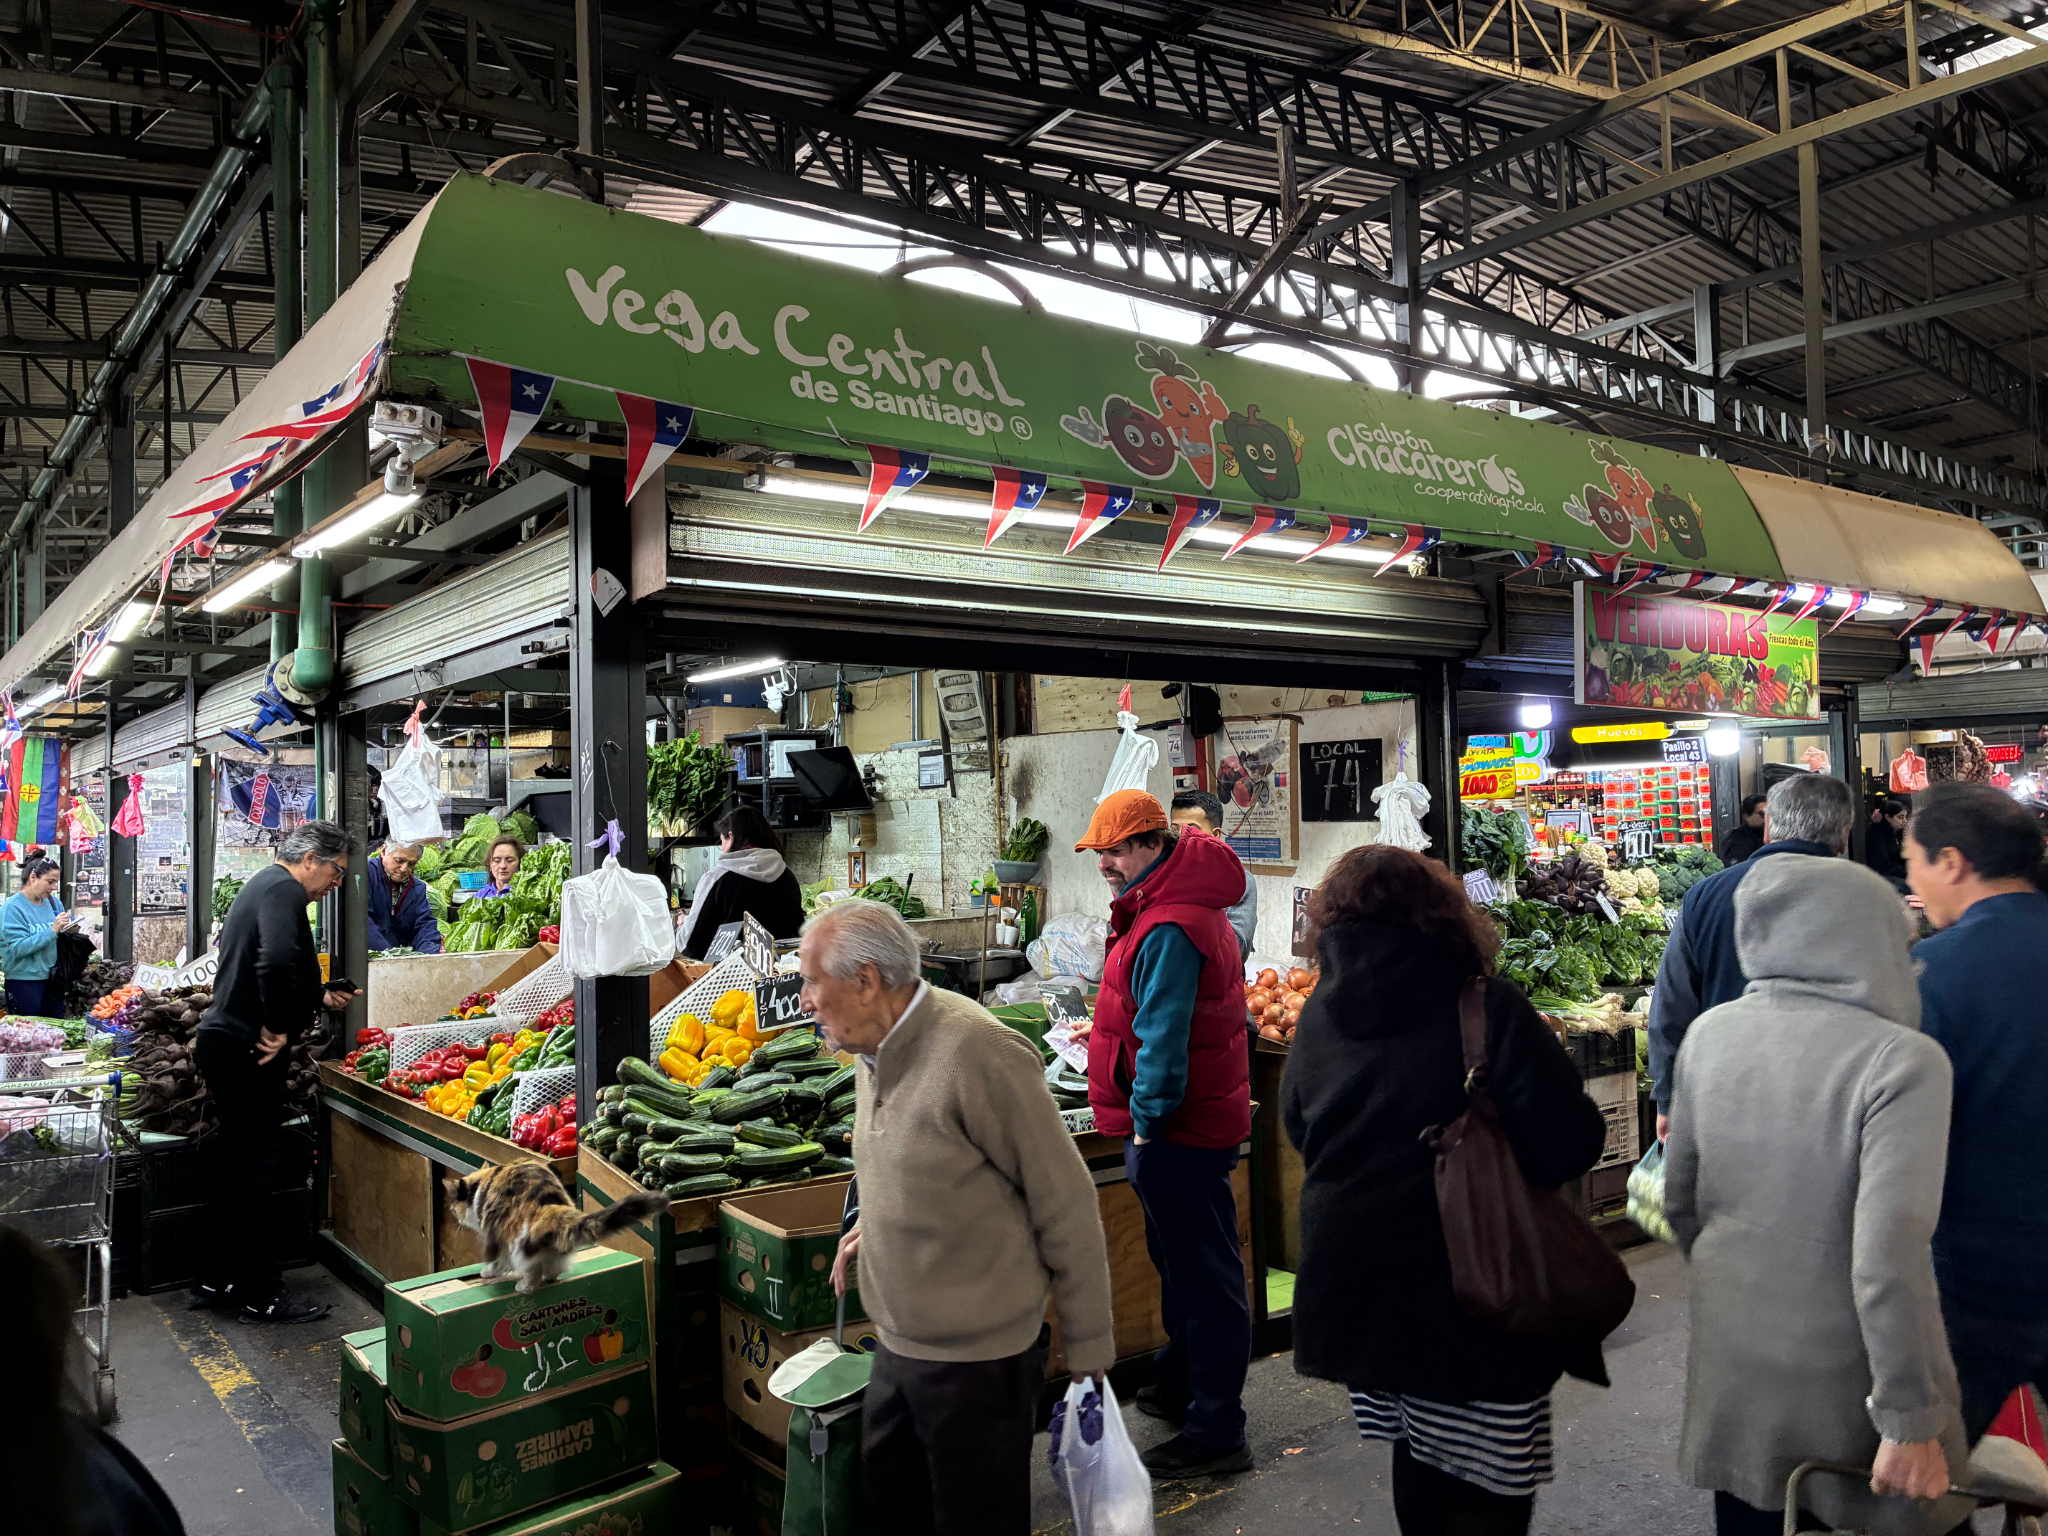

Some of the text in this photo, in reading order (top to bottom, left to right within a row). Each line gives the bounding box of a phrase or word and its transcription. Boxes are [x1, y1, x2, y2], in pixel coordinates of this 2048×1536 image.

[565, 265, 1026, 407] Vega Central
[790, 370, 839, 403] de
[847, 378, 1005, 436] Santiago
[1353, 422, 1435, 454] Galpón
[1326, 423, 1526, 496] Chacareros
[1591, 590, 1769, 660] VERDURAS
[1768, 633, 1788, 645] Frescas
[1788, 634, 1799, 646] todo
[1169, 741, 1180, 752] 74
[1597, 728, 1643, 738] Huevos
[1662, 741, 1699, 752] Pasillo 2
[1310, 743, 1366, 760] LOCAL
[1468, 749, 1496, 757] OFERTA
[1664, 751, 1700, 762] Local 43
[1314, 759, 1361, 814] 74
[1460, 774, 1498, 797] 1000
[519, 1296, 588, 1324] CARTONES
[519, 1304, 604, 1337] SAN ANDRES
[515, 1417, 595, 1460] RAMIREZ
[520, 1436, 593, 1473] CARTONES
